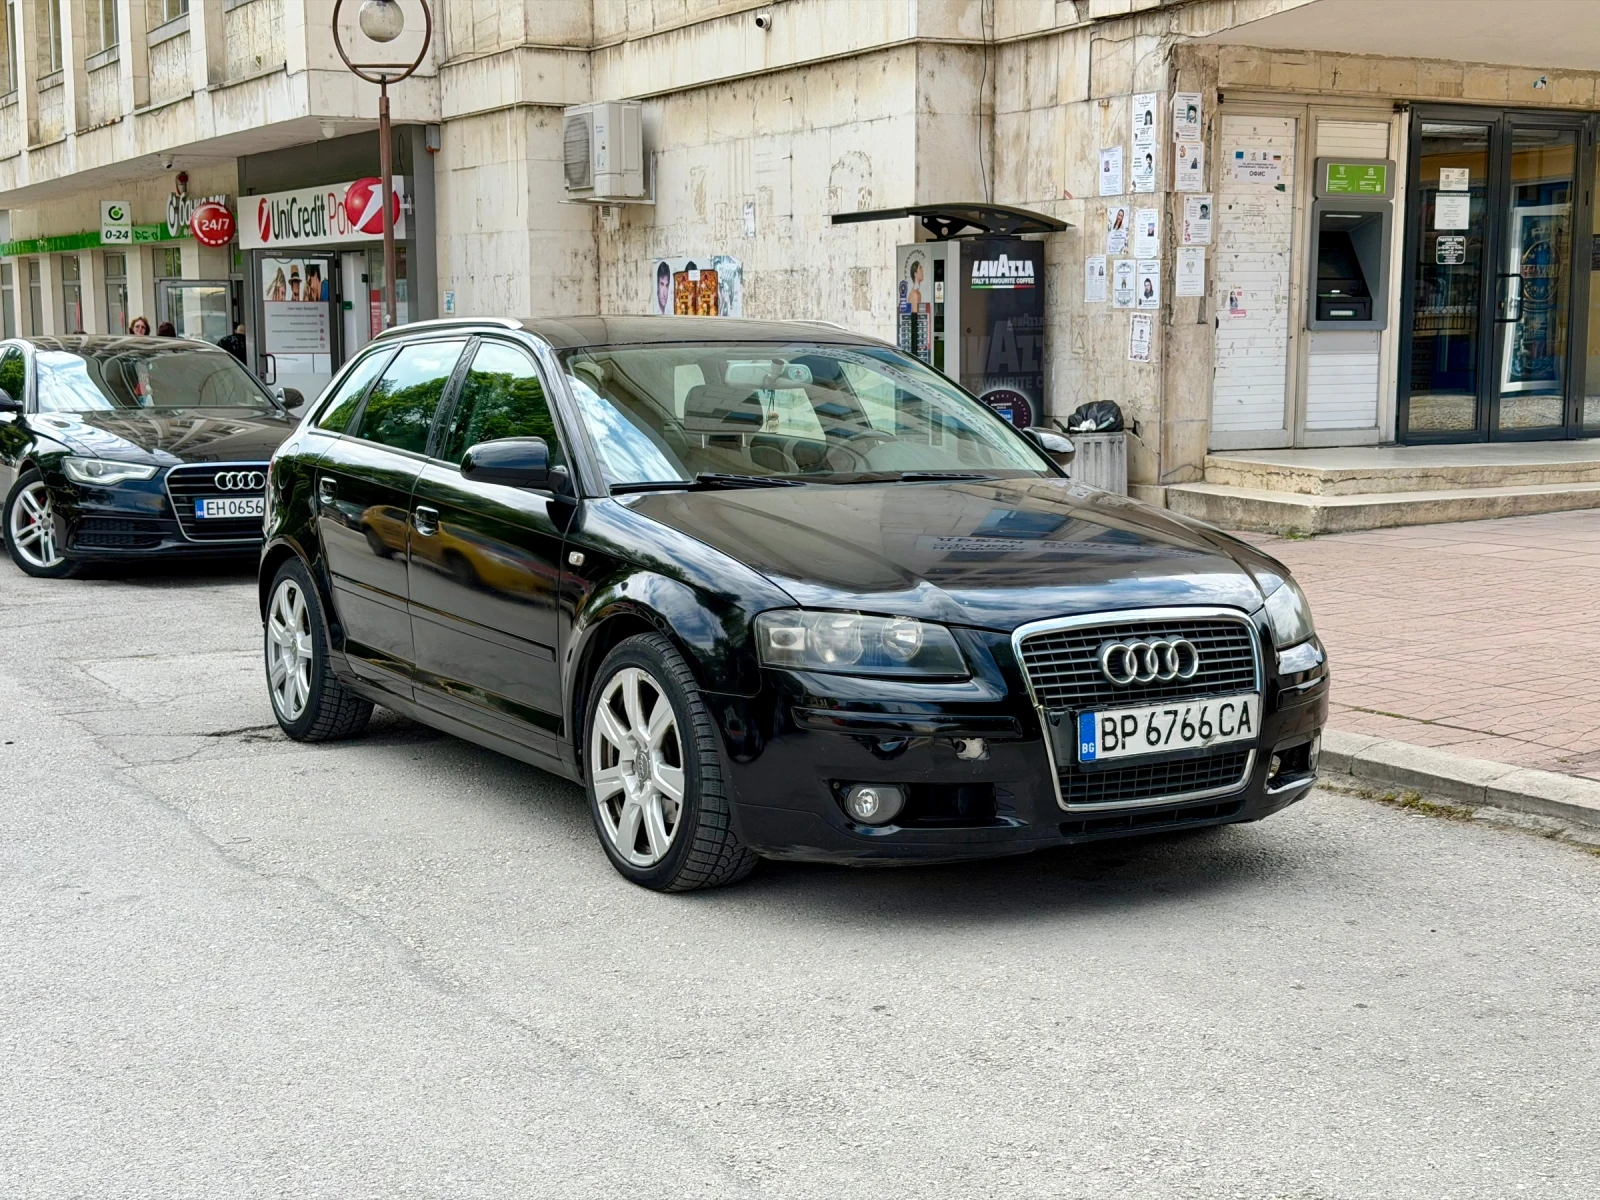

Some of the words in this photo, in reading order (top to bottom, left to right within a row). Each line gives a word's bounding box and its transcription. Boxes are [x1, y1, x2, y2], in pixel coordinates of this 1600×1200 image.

[271, 194, 326, 240] UniCredit
[201, 218, 230, 231] 24/7
[105, 229, 129, 240] 0-24
[971, 253, 1035, 277] LAVAZZA
[971, 277, 990, 285] ITALY'S
[972, 376, 1032, 390] FAVOURITE
[206, 501, 226, 516] EH
[228, 499, 264, 515] 0656
[1101, 714, 1138, 752] BP
[1146, 706, 1213, 746] 6766
[1218, 701, 1252, 737] CA
[1081, 742, 1095, 753] BG
